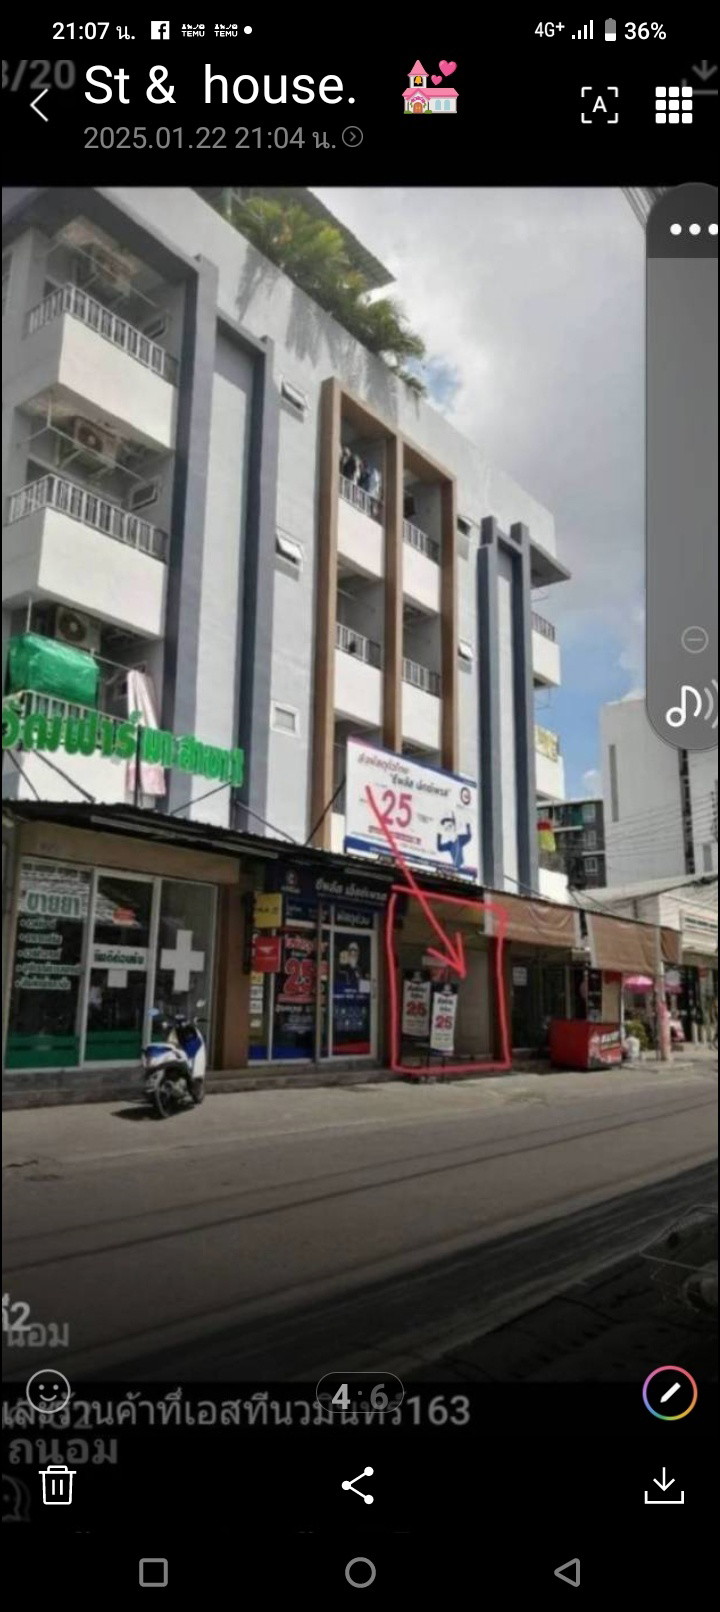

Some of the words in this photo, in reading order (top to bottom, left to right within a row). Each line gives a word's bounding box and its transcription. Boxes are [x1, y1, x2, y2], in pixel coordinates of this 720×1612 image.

[379, 789, 413, 828] 25
[26, 892, 80, 917] ขายยา
[435, 1015, 454, 1030] 25
